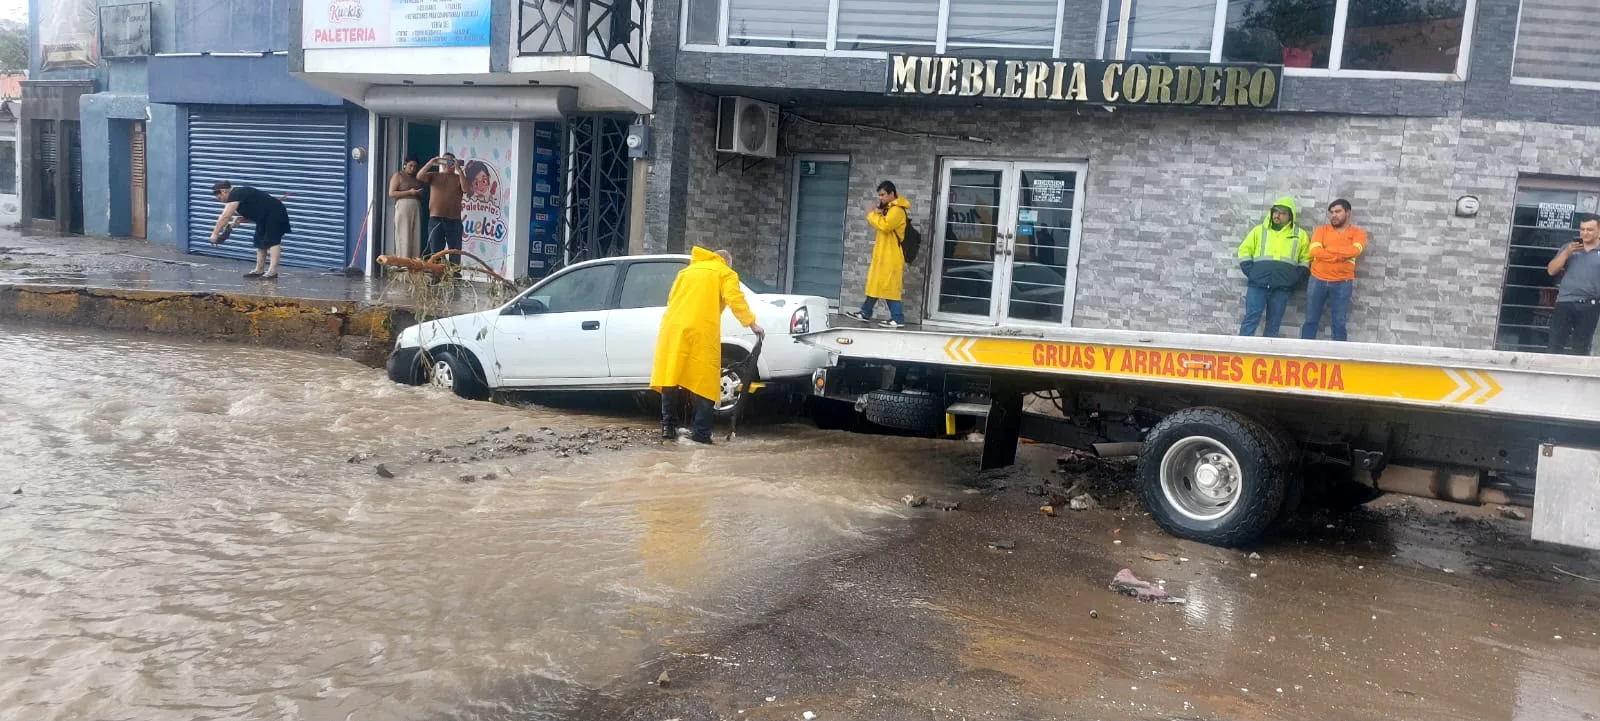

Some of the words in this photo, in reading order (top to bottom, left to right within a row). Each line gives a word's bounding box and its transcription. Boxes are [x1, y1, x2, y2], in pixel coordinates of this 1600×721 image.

[315, 28, 376, 42] PALETERIA
[891, 56, 1088, 100] MUEBLERIA
[1102, 63, 1276, 107] CORDERO
[1033, 344, 1095, 370] GRUAS
[1103, 348, 1115, 370] Y
[1120, 350, 1243, 382] ARRASTRES
[1252, 358, 1344, 391] GARCIA
